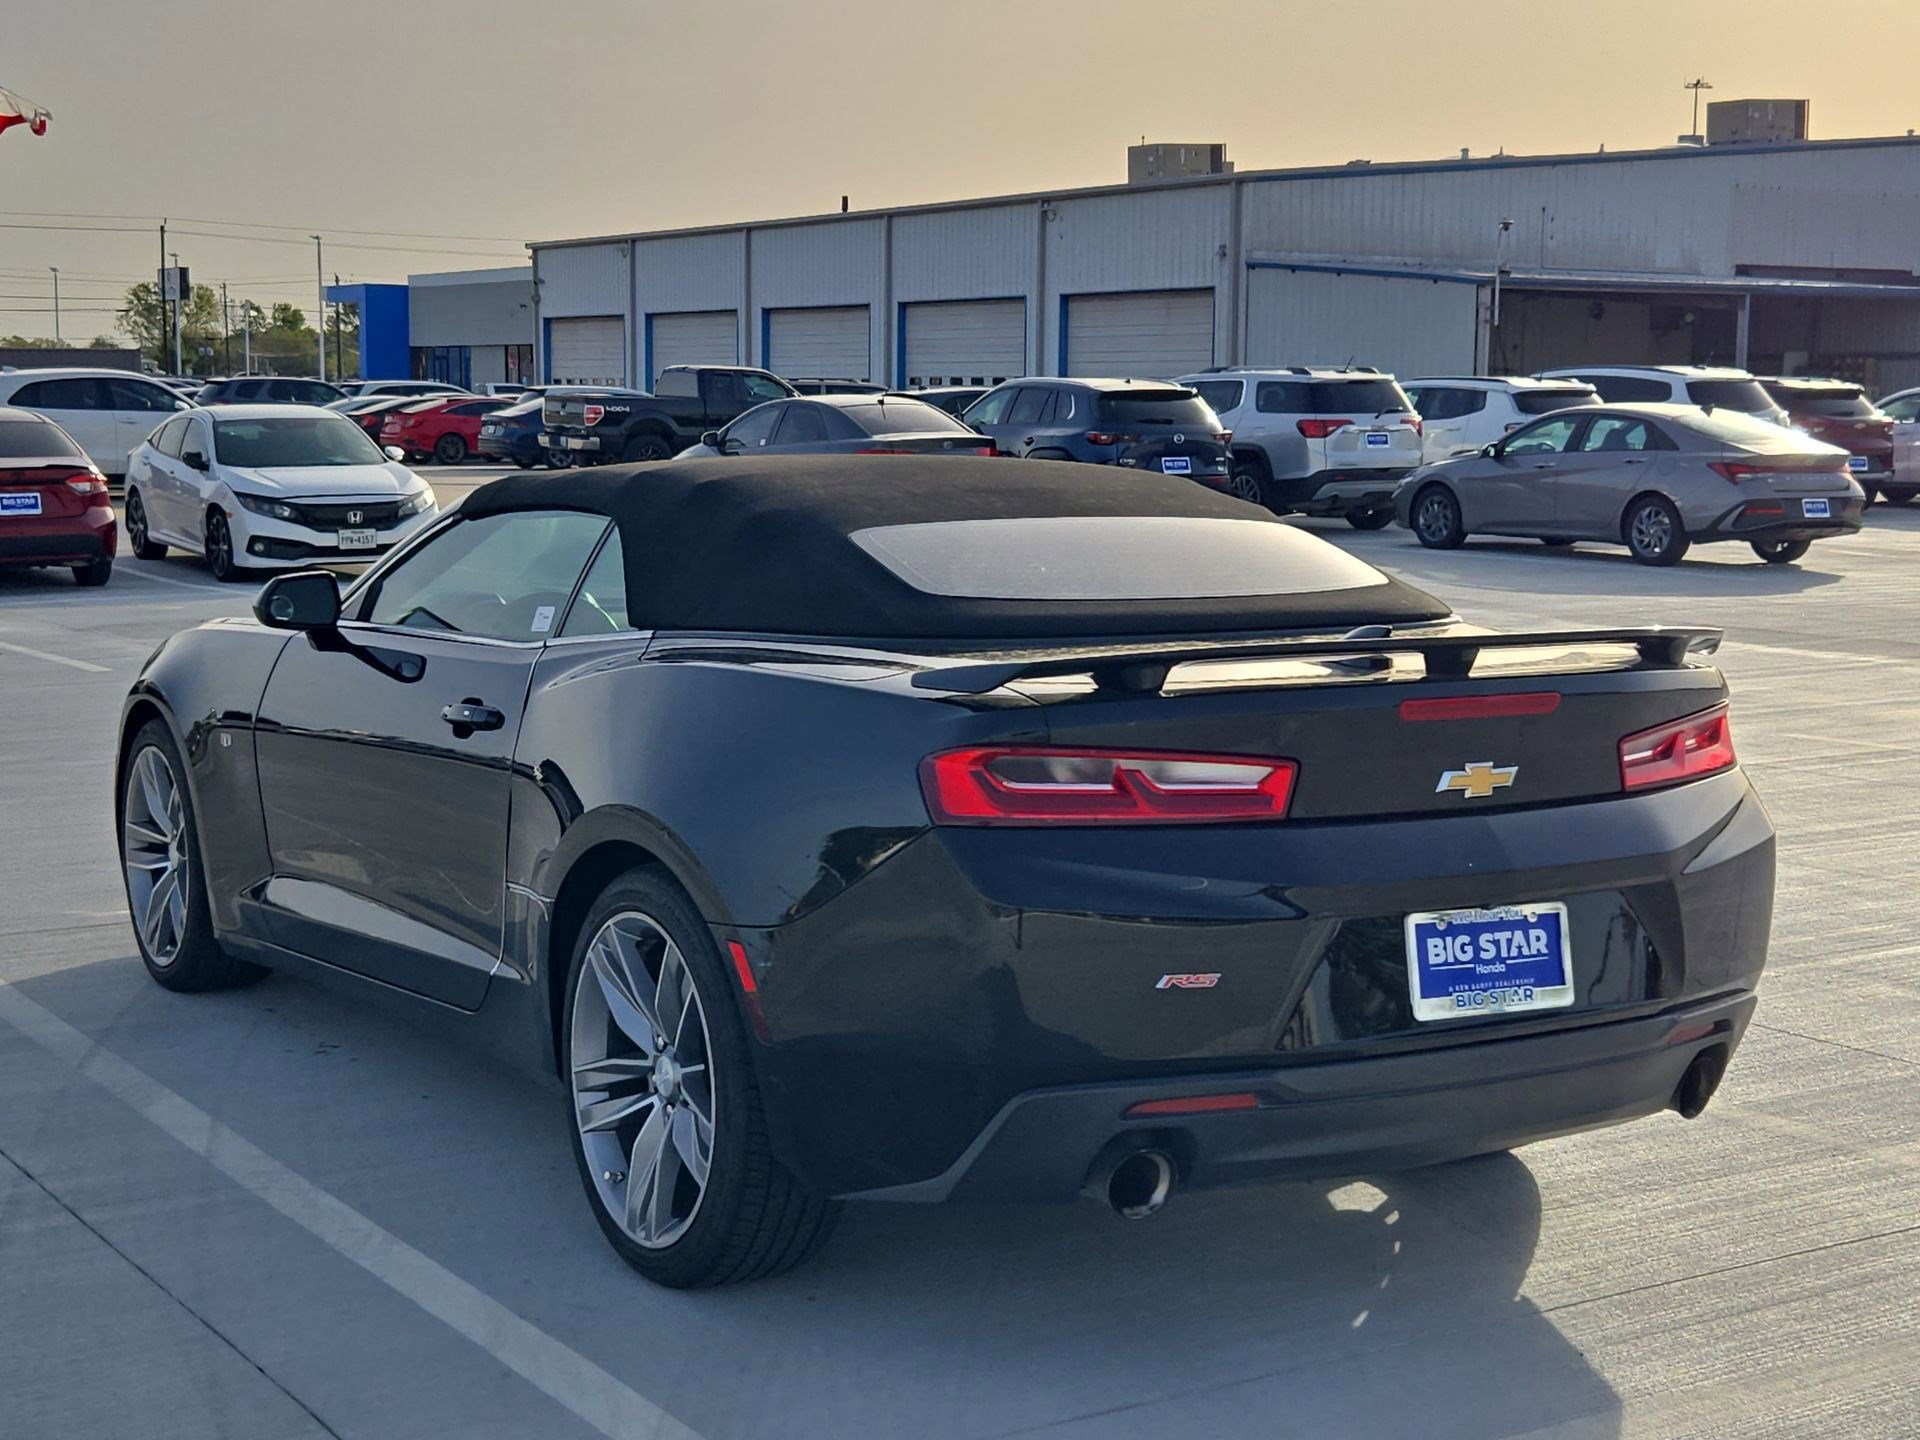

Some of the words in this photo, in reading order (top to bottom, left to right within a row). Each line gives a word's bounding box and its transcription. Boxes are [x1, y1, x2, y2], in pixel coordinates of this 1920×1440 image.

[1502, 906, 1523, 919] You
[1427, 934, 1474, 965] BIG
[1479, 928, 1549, 960] STAR
[1475, 961, 1506, 975] Honda
[1155, 972, 1222, 989] RS
[1495, 977, 1535, 988] DEALERSHIP
[1455, 992, 1485, 1008] BIG
[1489, 987, 1535, 1005] STAR
